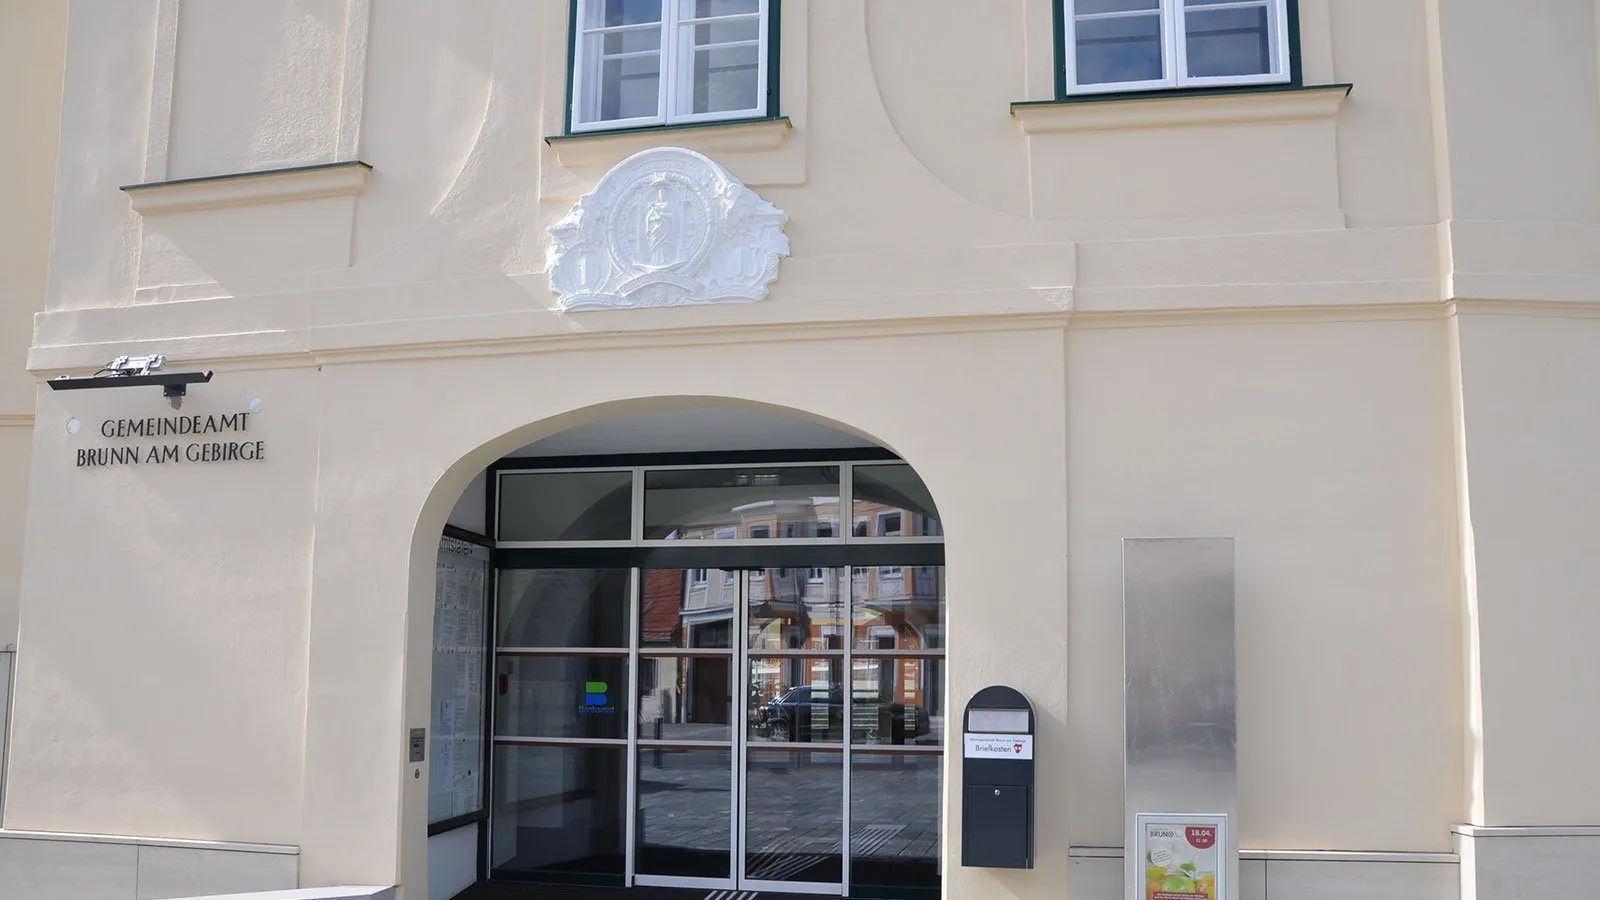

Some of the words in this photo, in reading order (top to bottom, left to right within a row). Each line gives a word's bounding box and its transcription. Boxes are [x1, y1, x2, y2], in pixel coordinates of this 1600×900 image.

[101, 412, 250, 438] GEMEINDEAMT
[76, 446, 140, 467] BRUNN
[145, 445, 179, 464] AM
[185, 441, 265, 462] GEBIRGE
[975, 744, 1012, 753] Briefkasten
